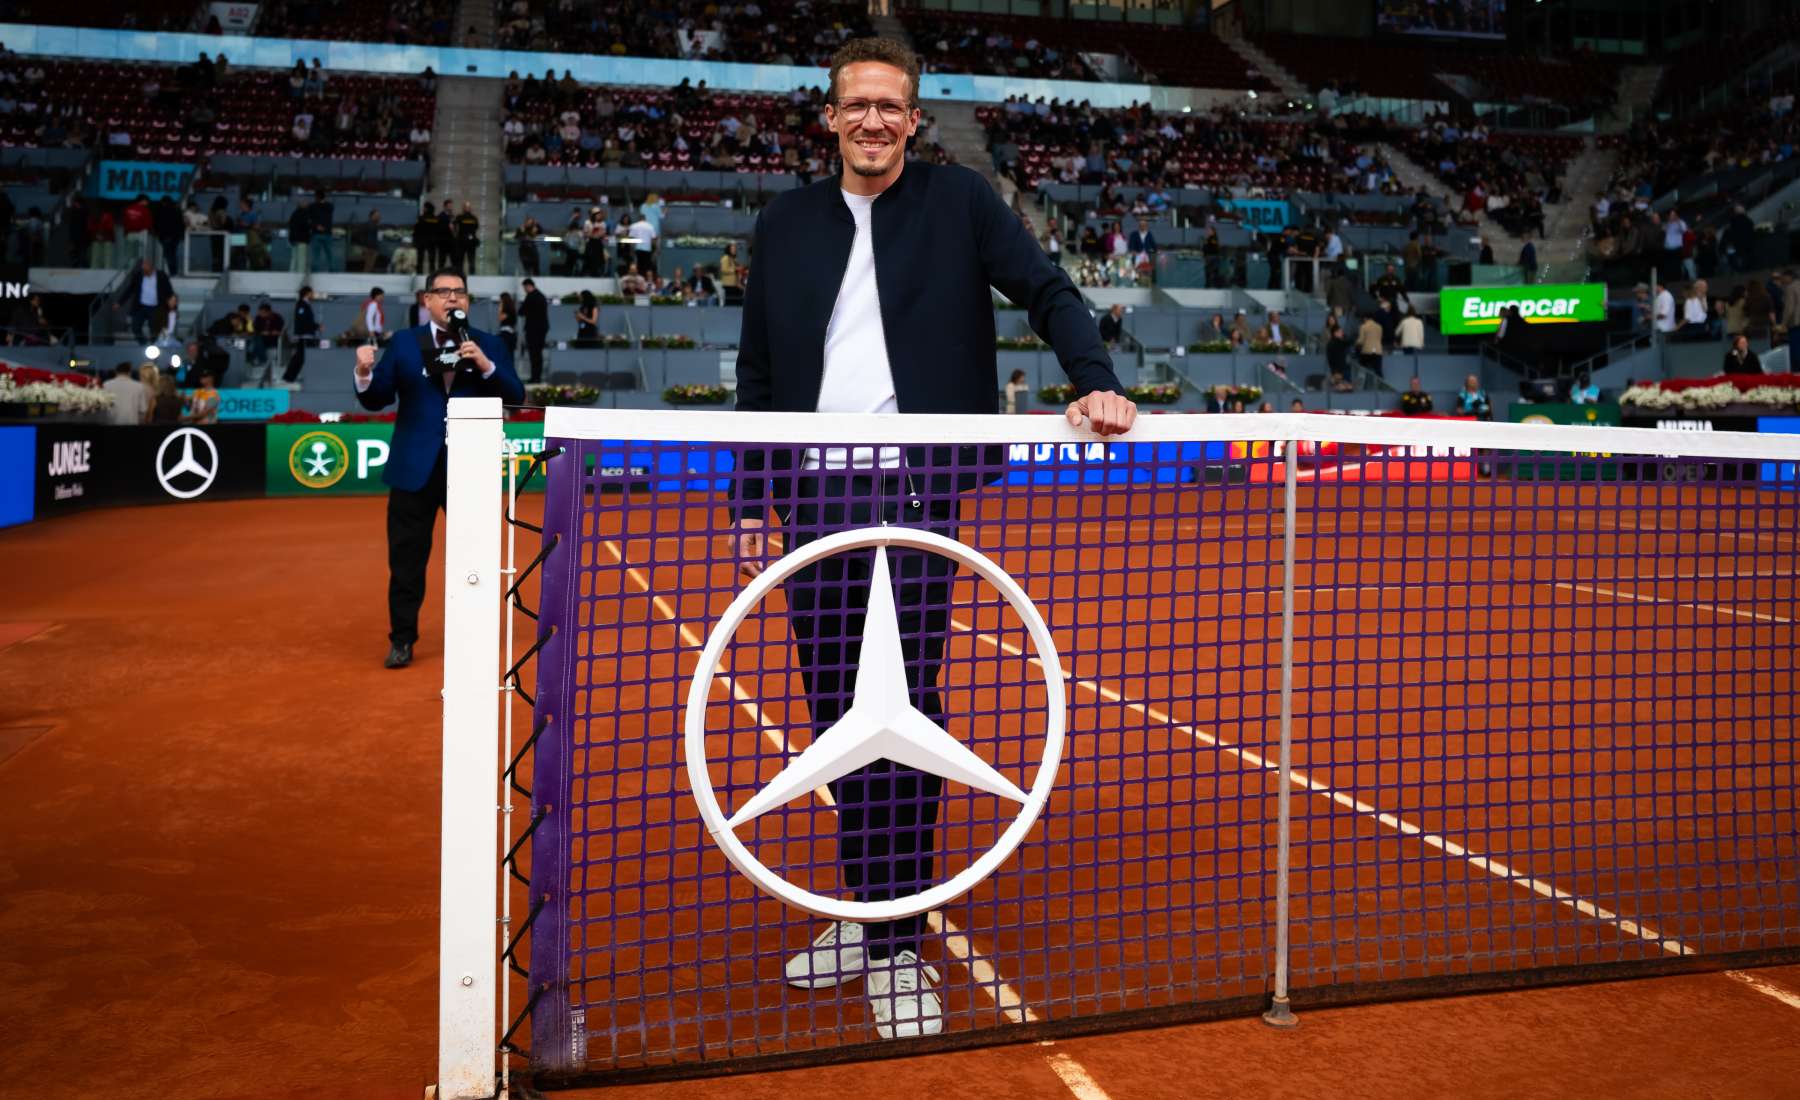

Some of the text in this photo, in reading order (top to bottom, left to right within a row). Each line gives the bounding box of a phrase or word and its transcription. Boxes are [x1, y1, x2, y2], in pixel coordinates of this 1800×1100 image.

[219, 399, 275, 414] ORES
[48, 440, 91, 477] JUNGLE
[592, 467, 644, 477] ACOTE
